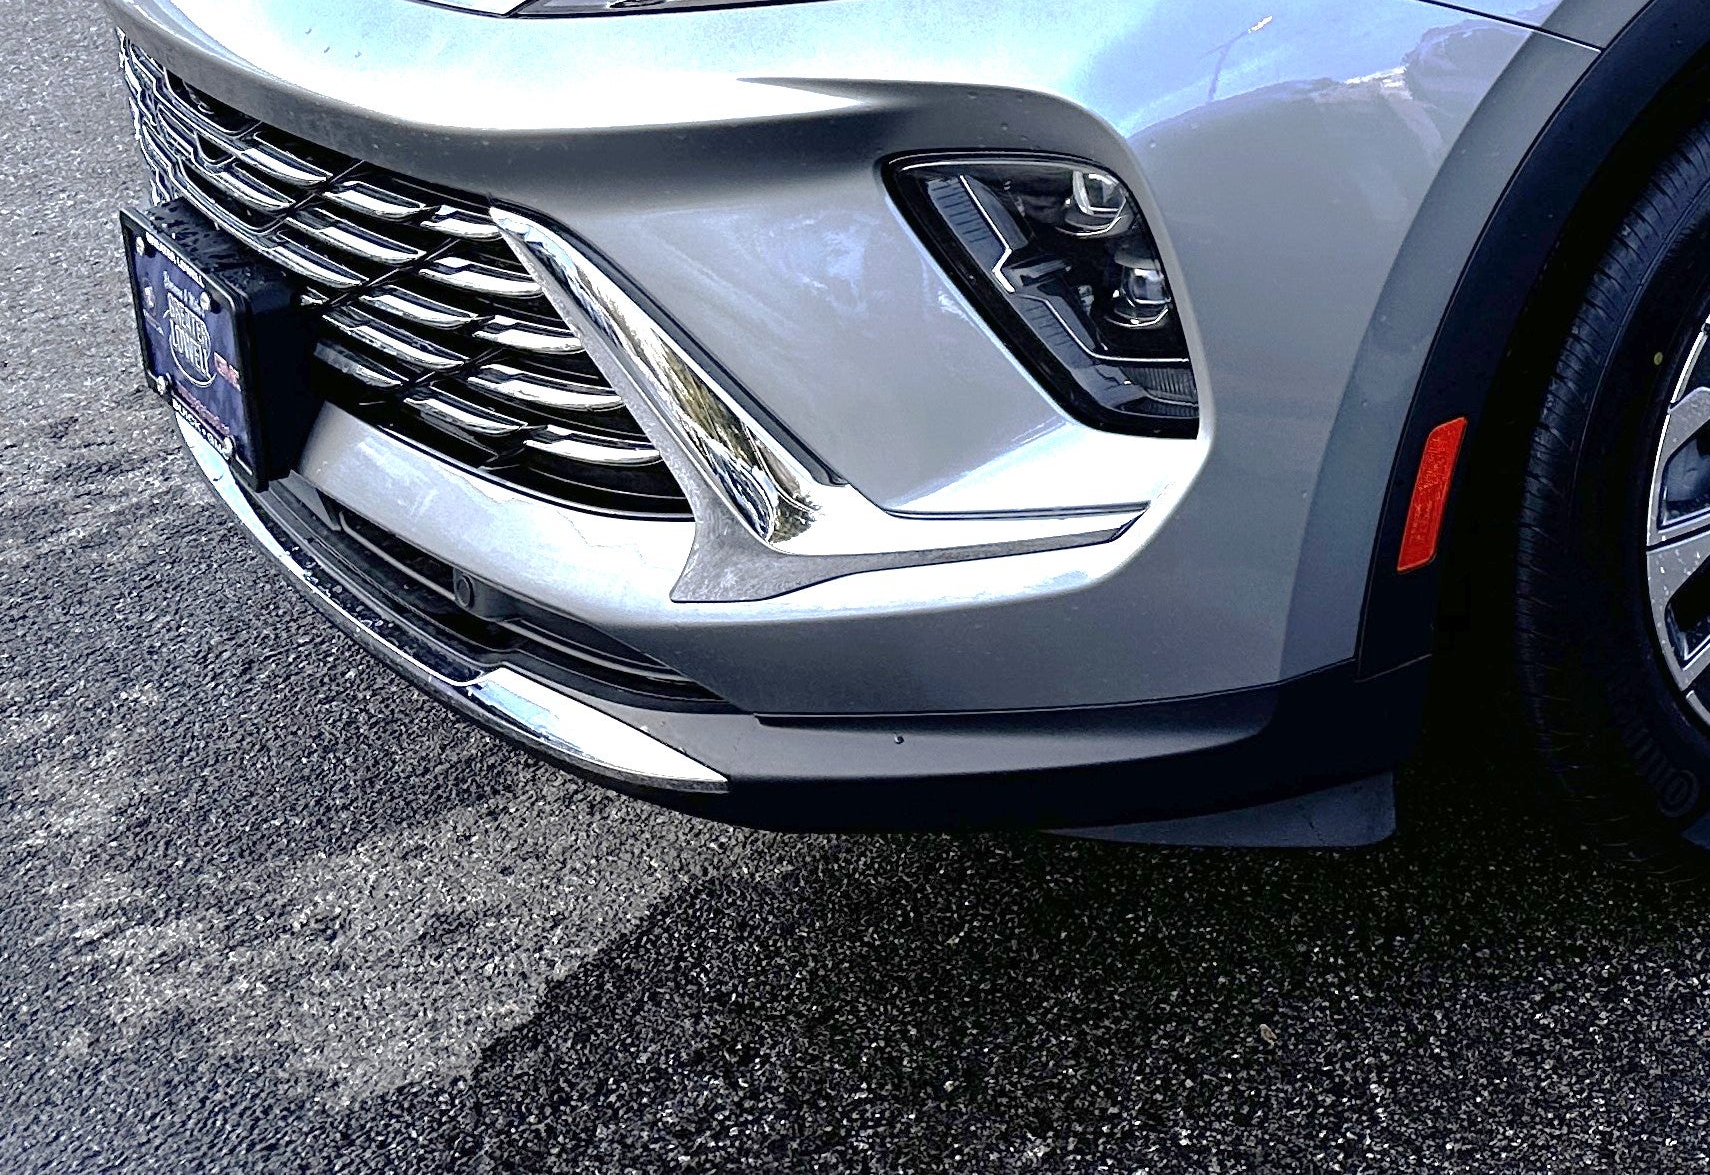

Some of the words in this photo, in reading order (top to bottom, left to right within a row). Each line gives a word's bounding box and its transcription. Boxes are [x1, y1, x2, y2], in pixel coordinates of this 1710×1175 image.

[168, 294, 210, 345] GREATER
[170, 319, 212, 381] LOWELL
[172, 398, 202, 432] BUICK
